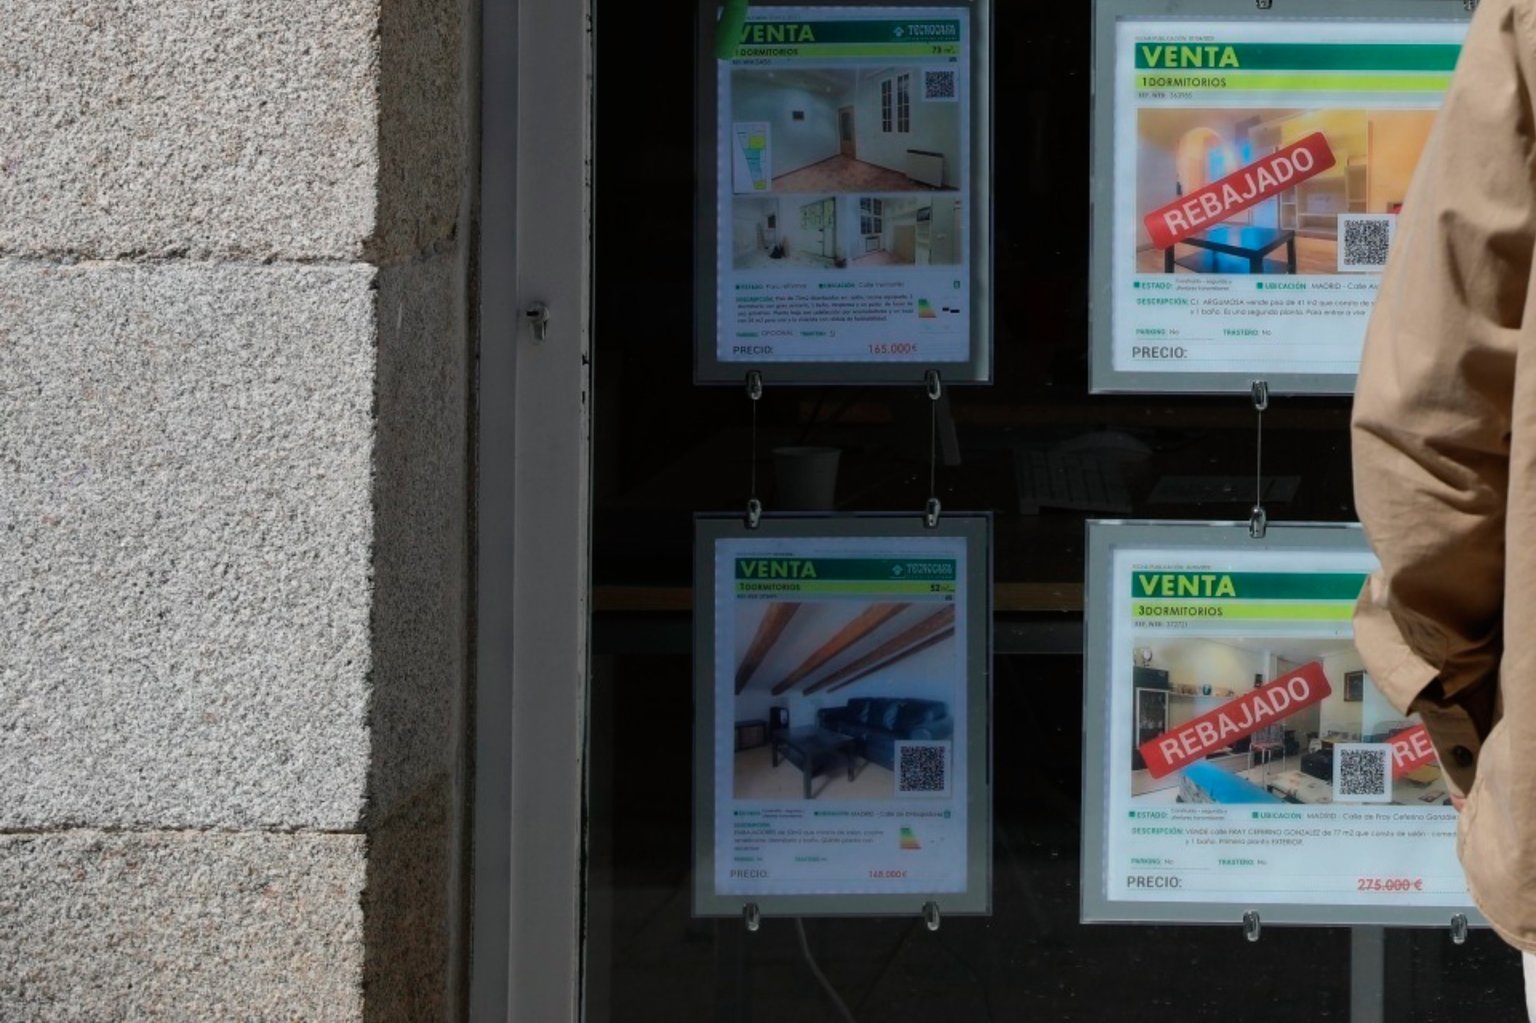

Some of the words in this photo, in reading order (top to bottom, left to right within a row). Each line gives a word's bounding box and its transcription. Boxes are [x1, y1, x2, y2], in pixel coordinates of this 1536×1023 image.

[740, 24, 815, 43] VENTA
[740, 47, 798, 57] DORMITORIOS
[1142, 45, 1240, 68] VENTA
[1163, 147, 1314, 236] REBAJADO
[1311, 281, 1341, 290] MADRID
[1347, 281, 1366, 290] Calle
[732, 345, 774, 355] PRECIO:
[1132, 346, 1188, 359] PRECIO:
[739, 560, 817, 578] VENTA
[1138, 573, 1236, 597] VENTA
[1159, 676, 1310, 767] REBAJADO
[1306, 812, 1337, 820] MADRID
[1342, 812, 1362, 821] Calle
[730, 869, 768, 878] PRECIO:
[1127, 875, 1182, 888] PRECIO:
[1357, 878, 1411, 892] 275.000
[1413, 878, 1423, 891] €
